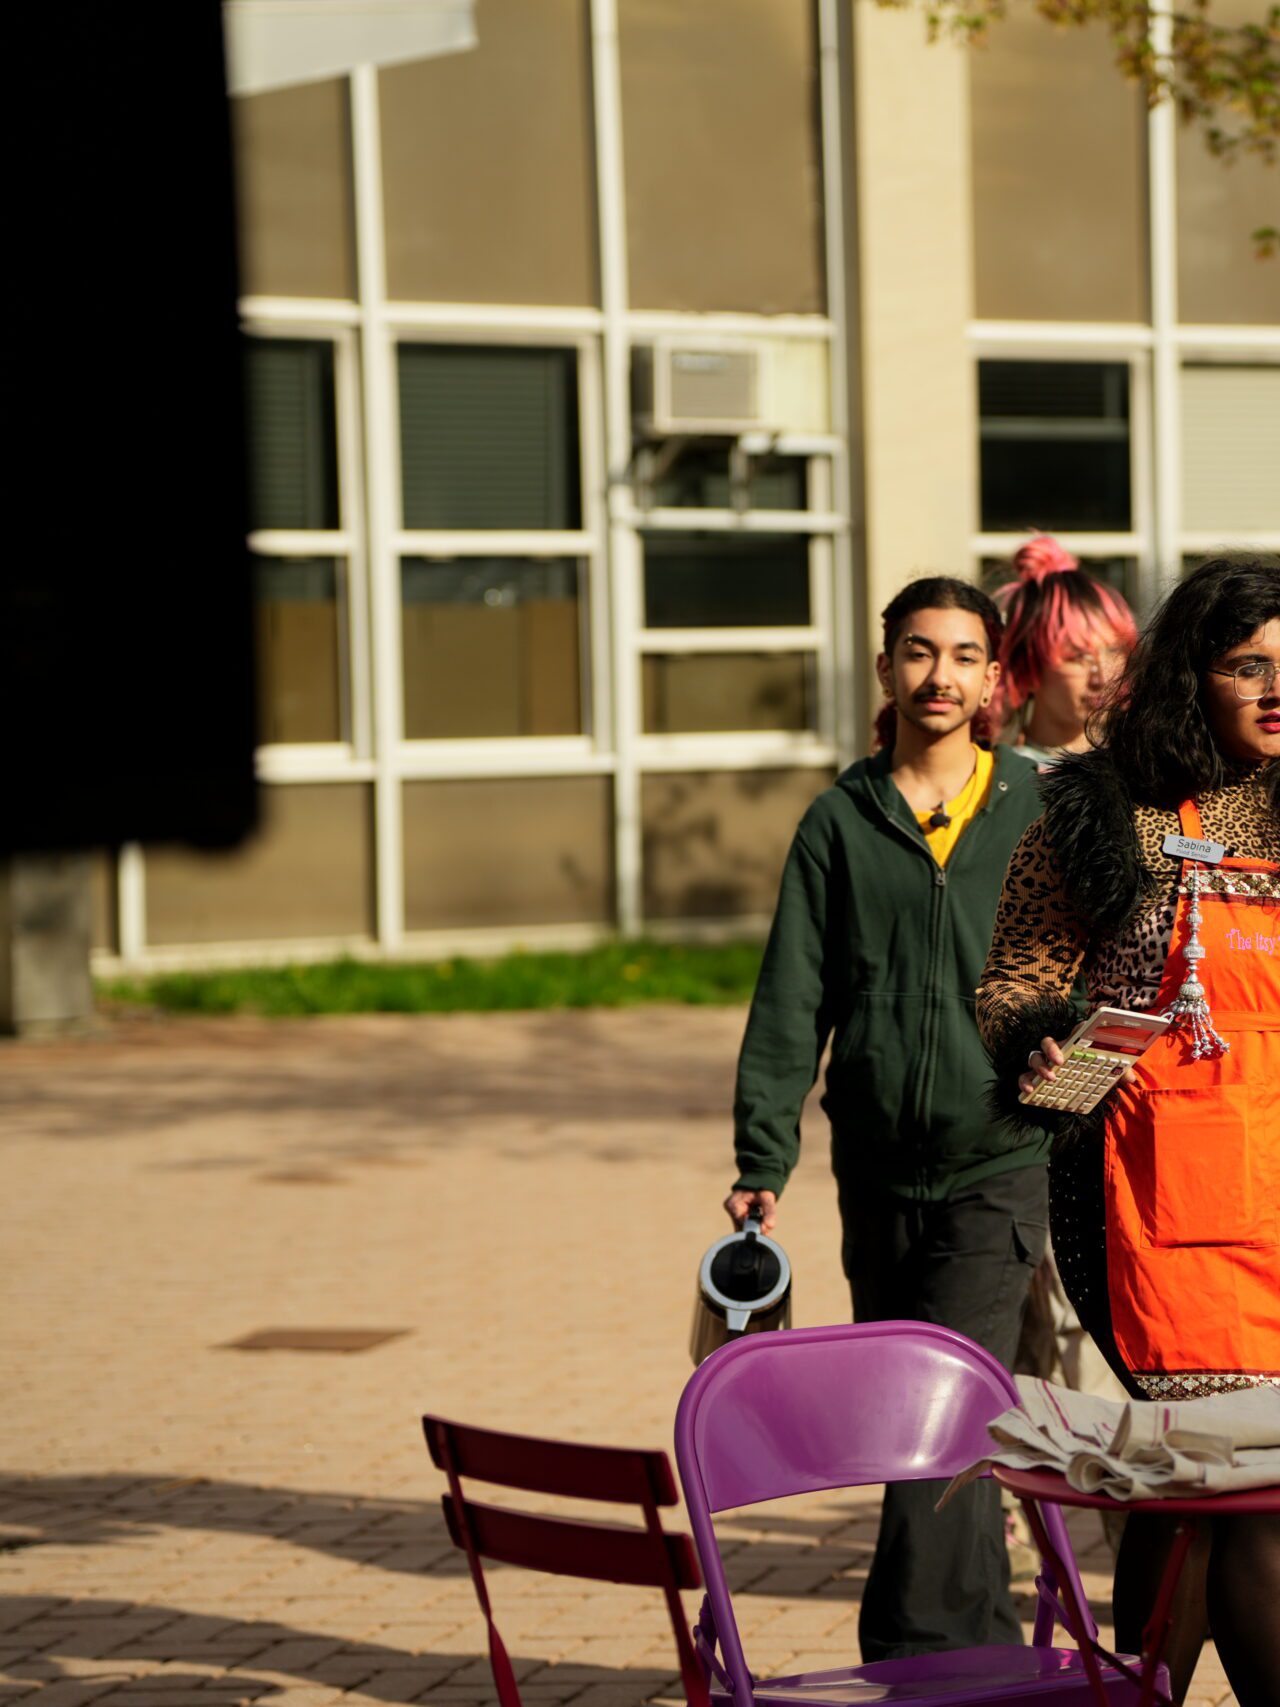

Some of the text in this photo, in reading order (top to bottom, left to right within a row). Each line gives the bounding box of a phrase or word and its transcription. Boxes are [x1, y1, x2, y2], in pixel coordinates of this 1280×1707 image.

[1177, 838, 1212, 853] Sabina
[1225, 928, 1252, 950] The
[1255, 932, 1275, 956] Itsy
